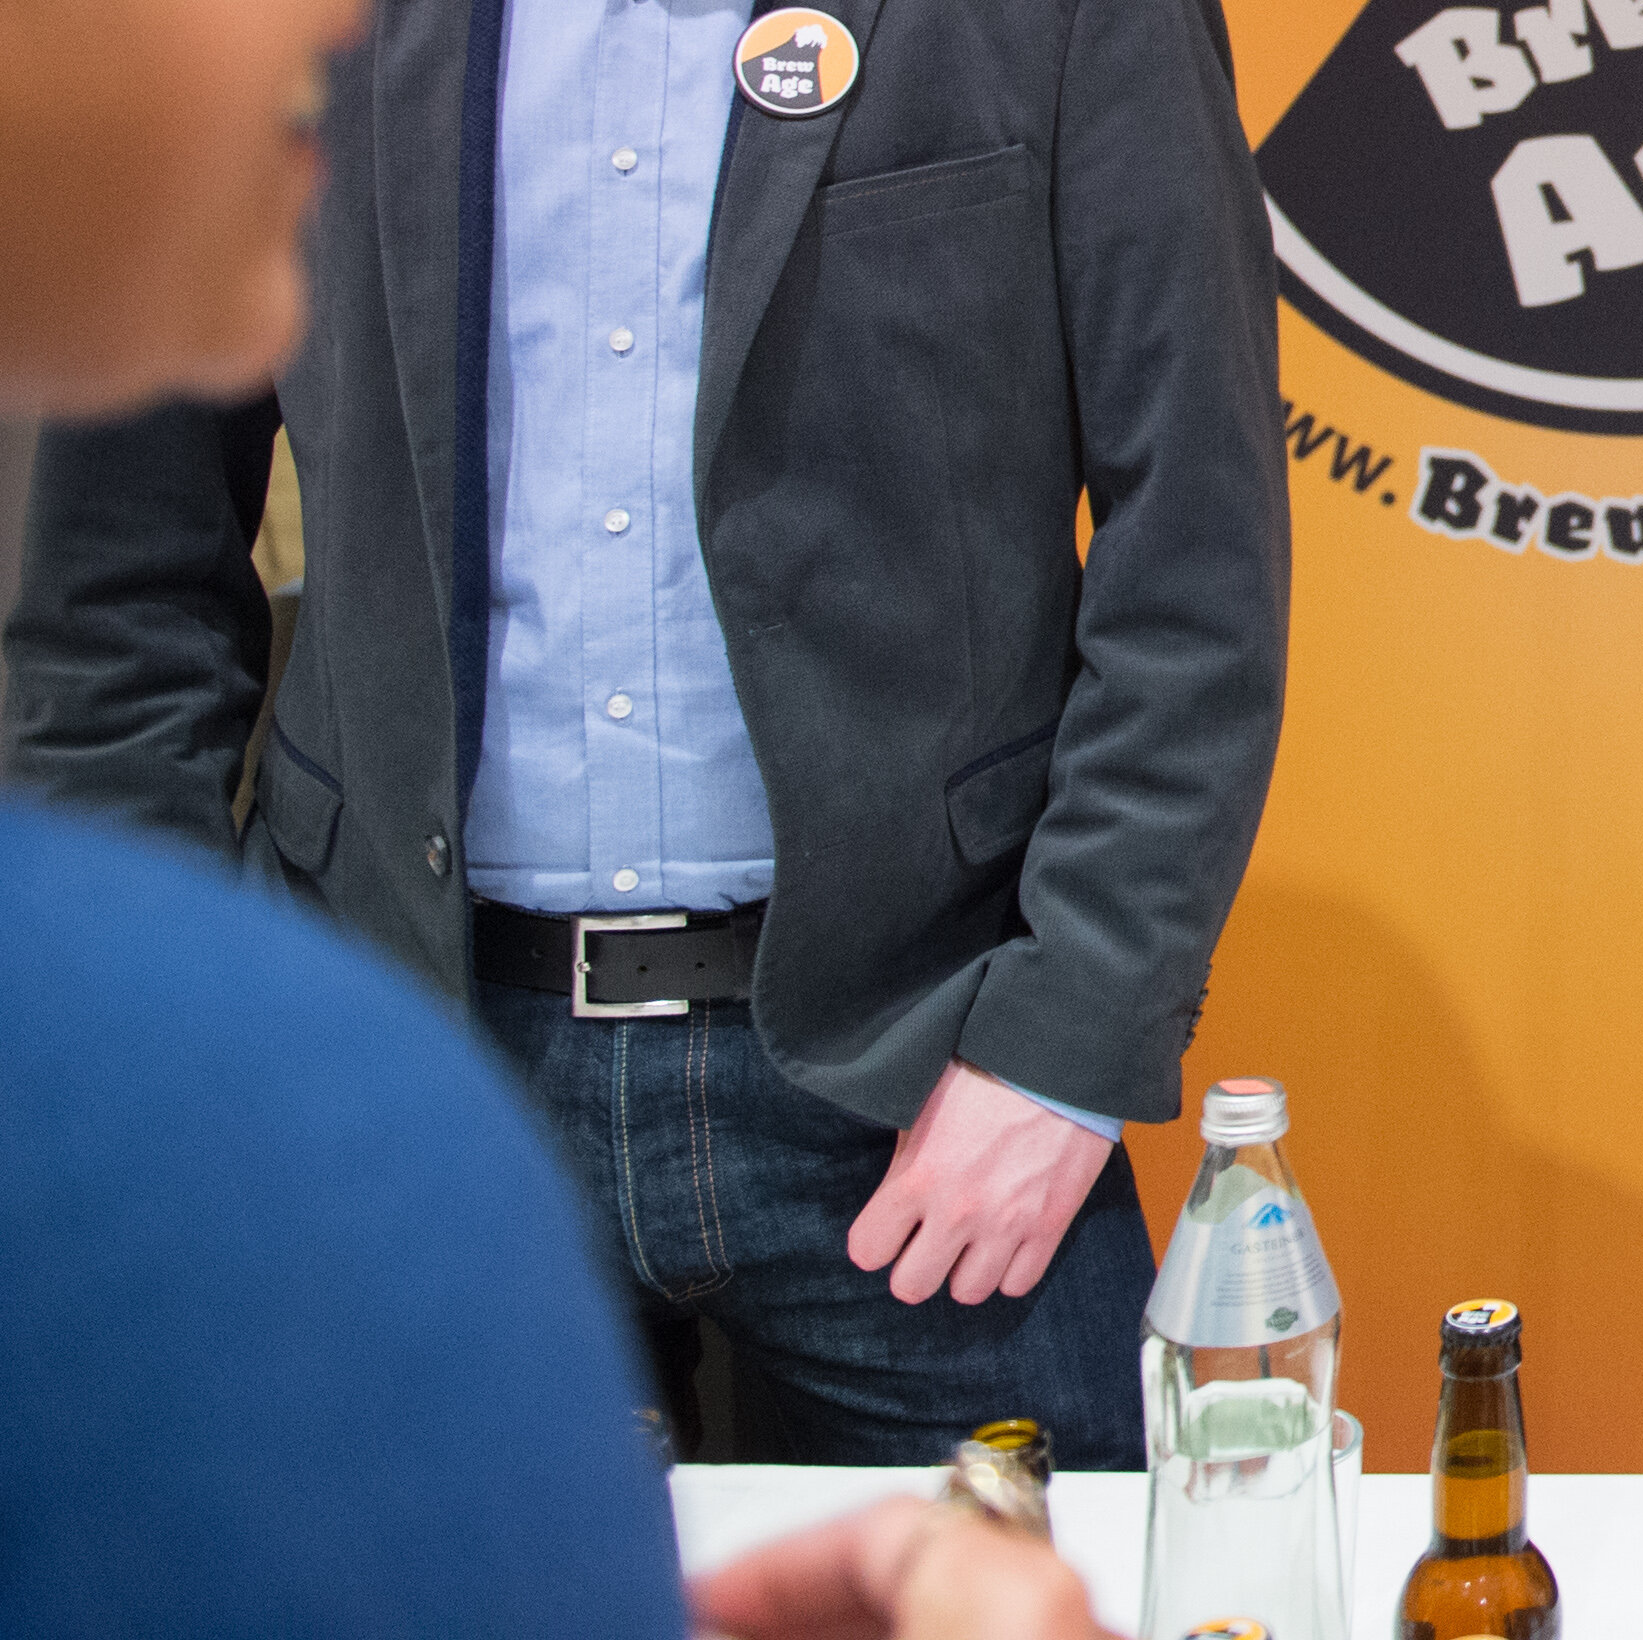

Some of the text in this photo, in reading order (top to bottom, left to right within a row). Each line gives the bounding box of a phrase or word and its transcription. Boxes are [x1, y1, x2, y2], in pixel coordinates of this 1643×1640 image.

[762, 56, 815, 72] Brew
[760, 73, 814, 99] Age
[1230, 1226, 1305, 1255] GASTEINR
